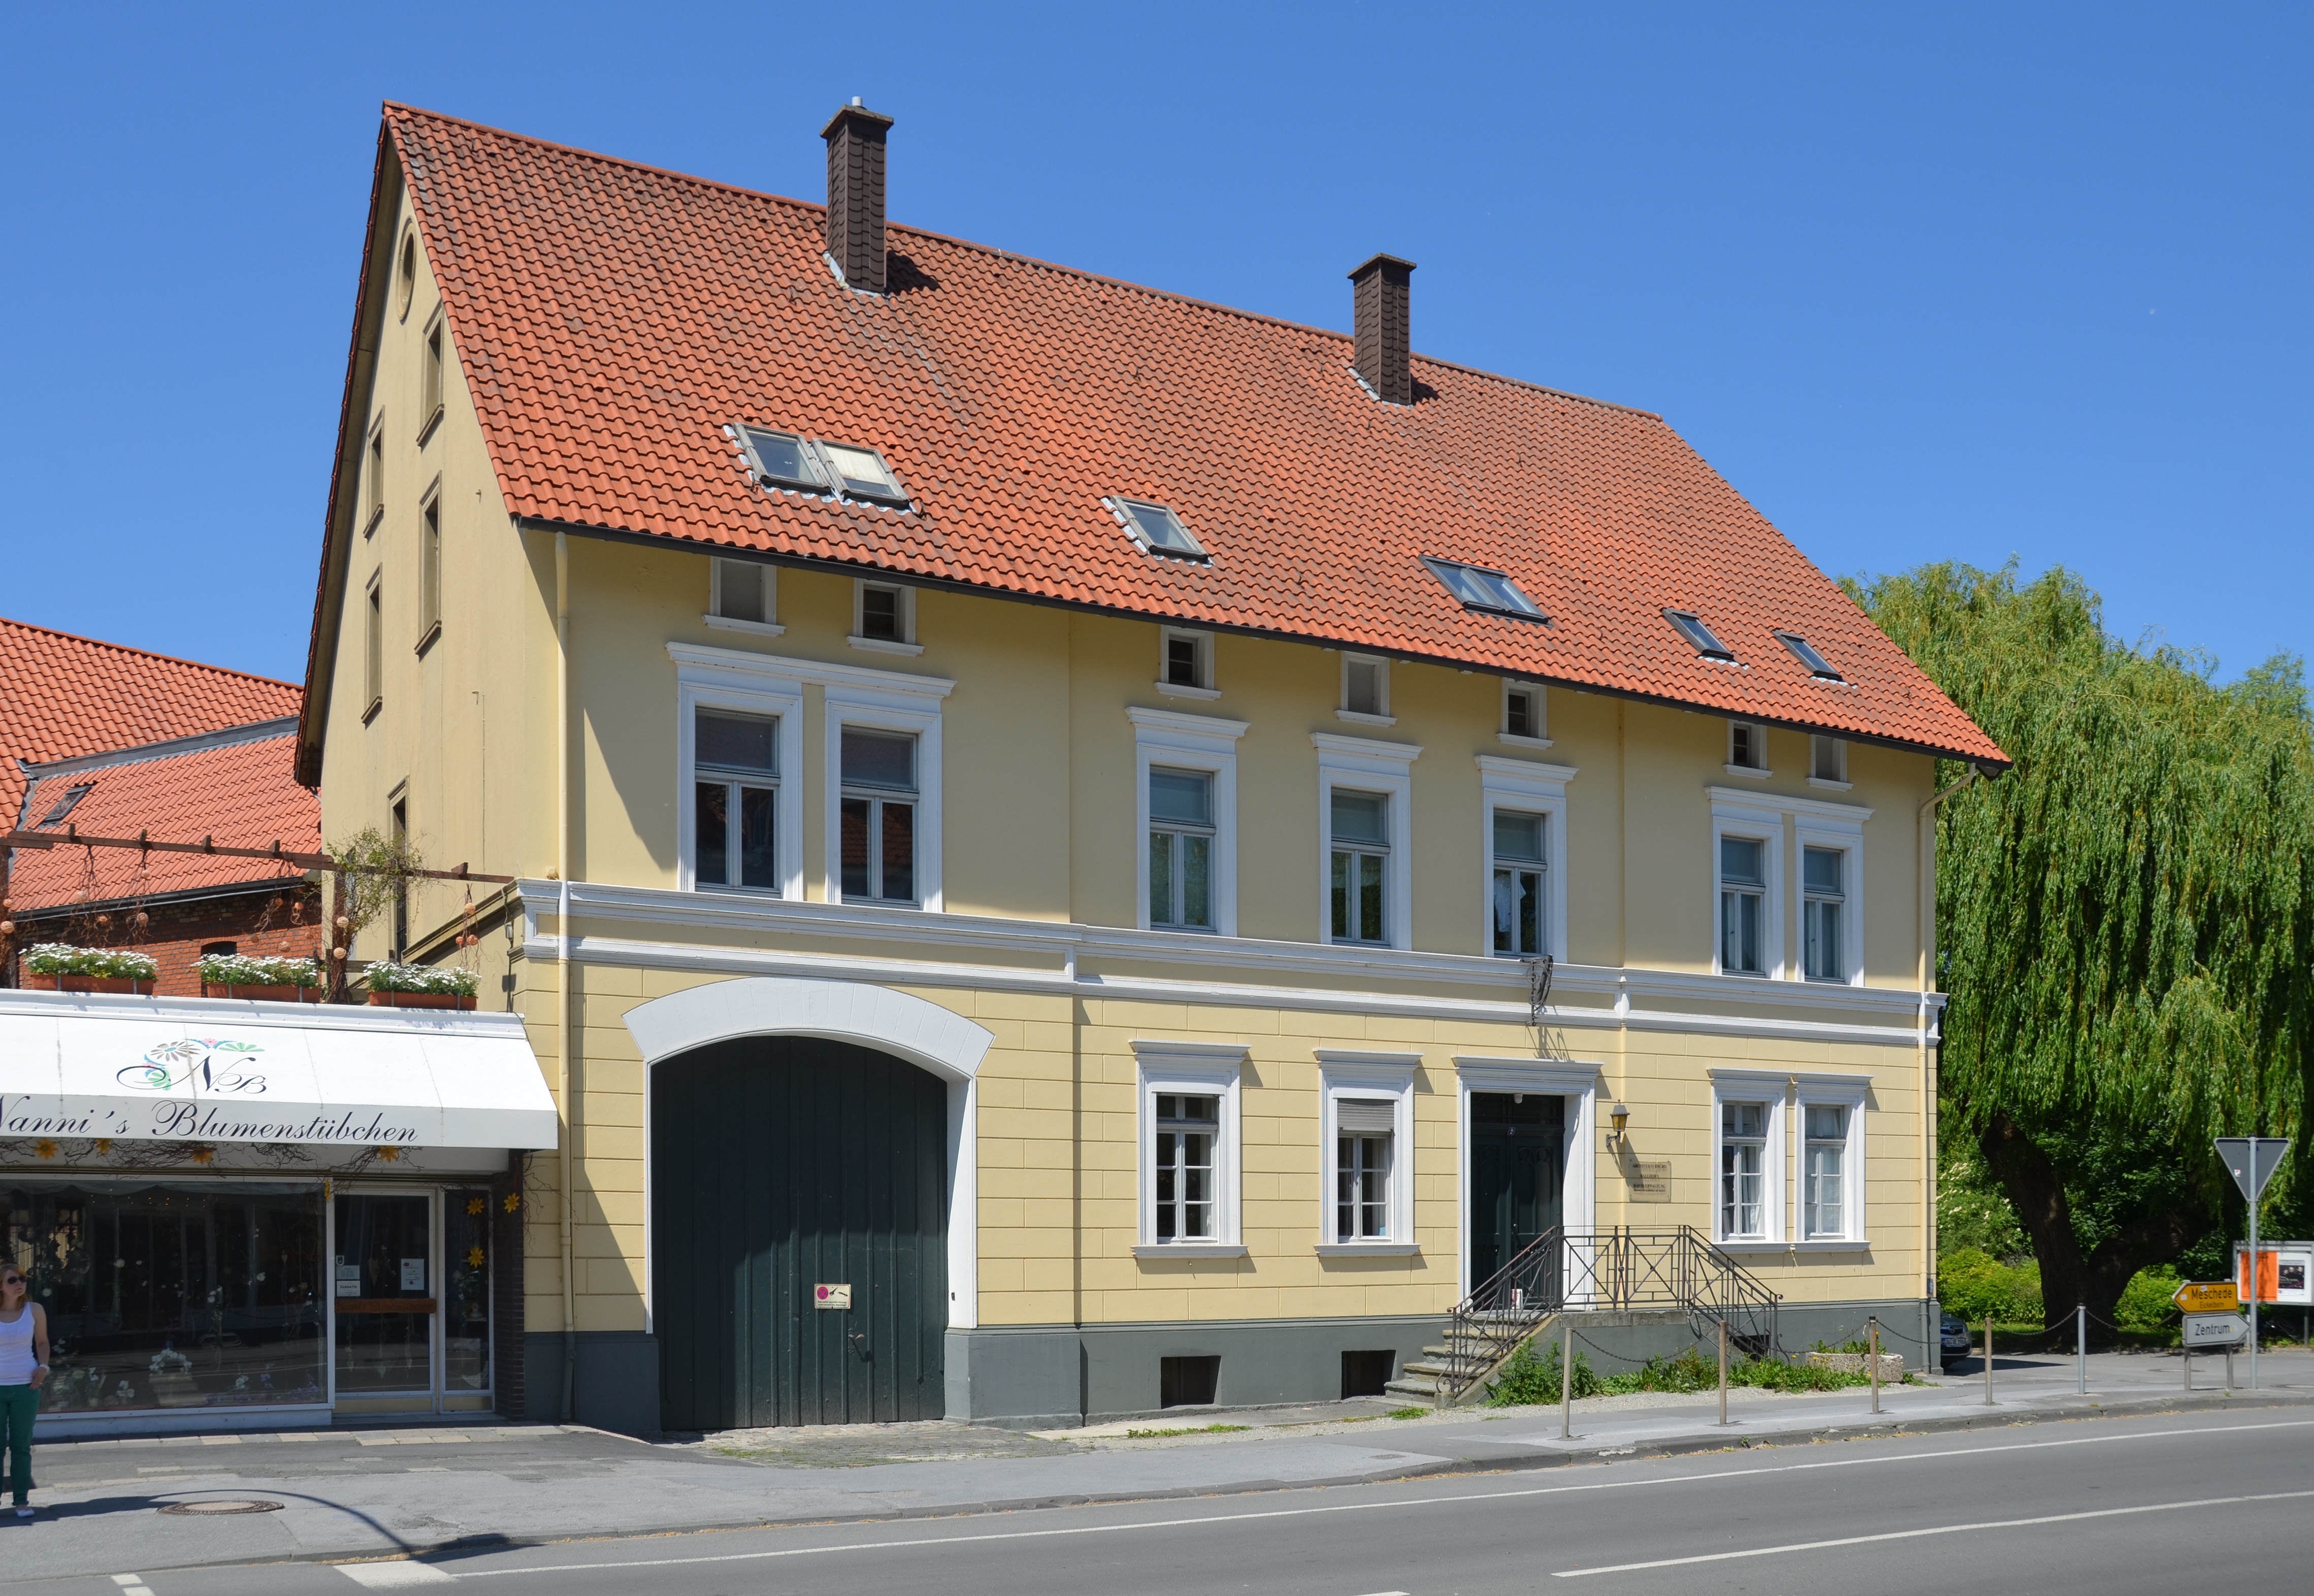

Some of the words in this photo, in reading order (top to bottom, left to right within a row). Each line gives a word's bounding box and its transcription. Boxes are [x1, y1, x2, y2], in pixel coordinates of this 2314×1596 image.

[151, 1100, 418, 1142] Blumenstübchen
[2192, 1287, 2232, 1300] Meschede
[2195, 1323, 2230, 1336] Zentrum
